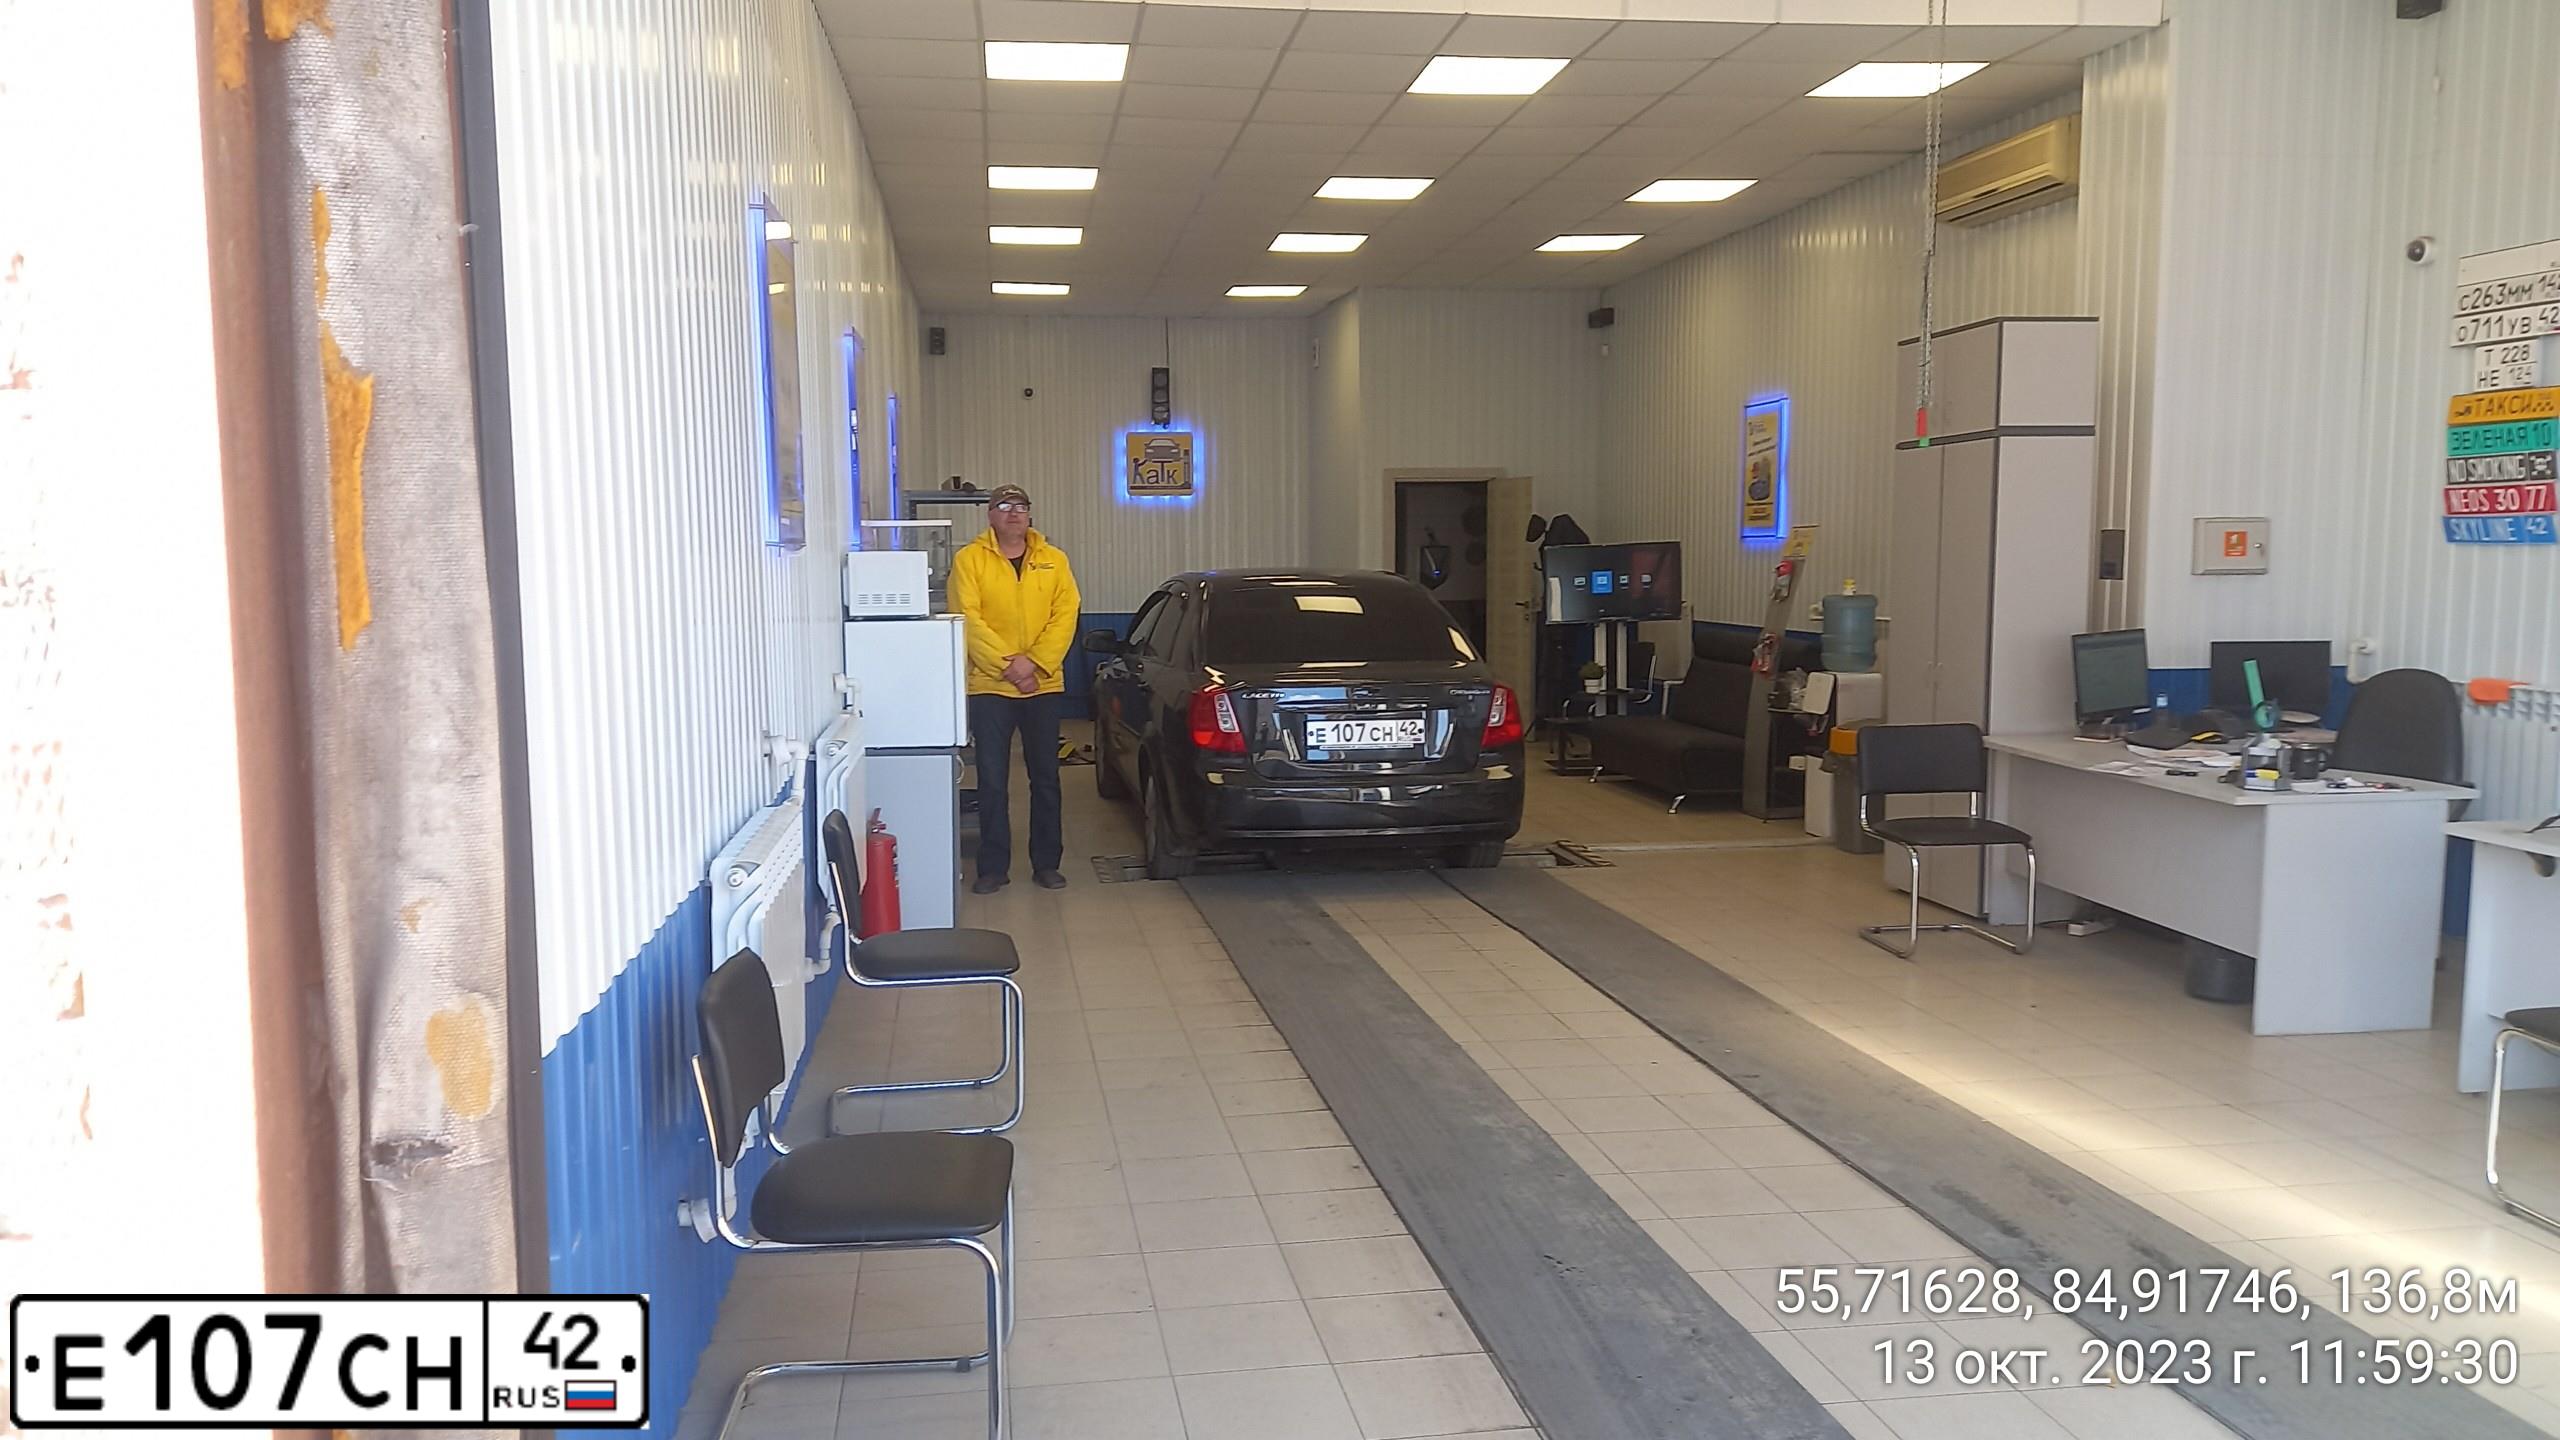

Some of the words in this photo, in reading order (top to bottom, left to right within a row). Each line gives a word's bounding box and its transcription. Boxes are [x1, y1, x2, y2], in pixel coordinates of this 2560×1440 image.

[2538, 273, 2560, 293] 14
[2539, 306, 2560, 325] 42
[2501, 344, 2530, 364] 228
[2475, 394, 2533, 416] ТАКСИ
[2451, 426, 2528, 450] ЗЕЛЕНАЯ
[2532, 422, 2552, 446] 10
[2448, 459, 2467, 482] NO
[2467, 455, 2526, 480] SMOKING
[2448, 488, 2490, 513] NEOS
[2493, 487, 2521, 511] 30
[2524, 485, 2548, 511] 77
[2449, 518, 2518, 540] SKYLINE
[2526, 517, 2548, 534] 42
[1400, 721, 1418, 736] 42
